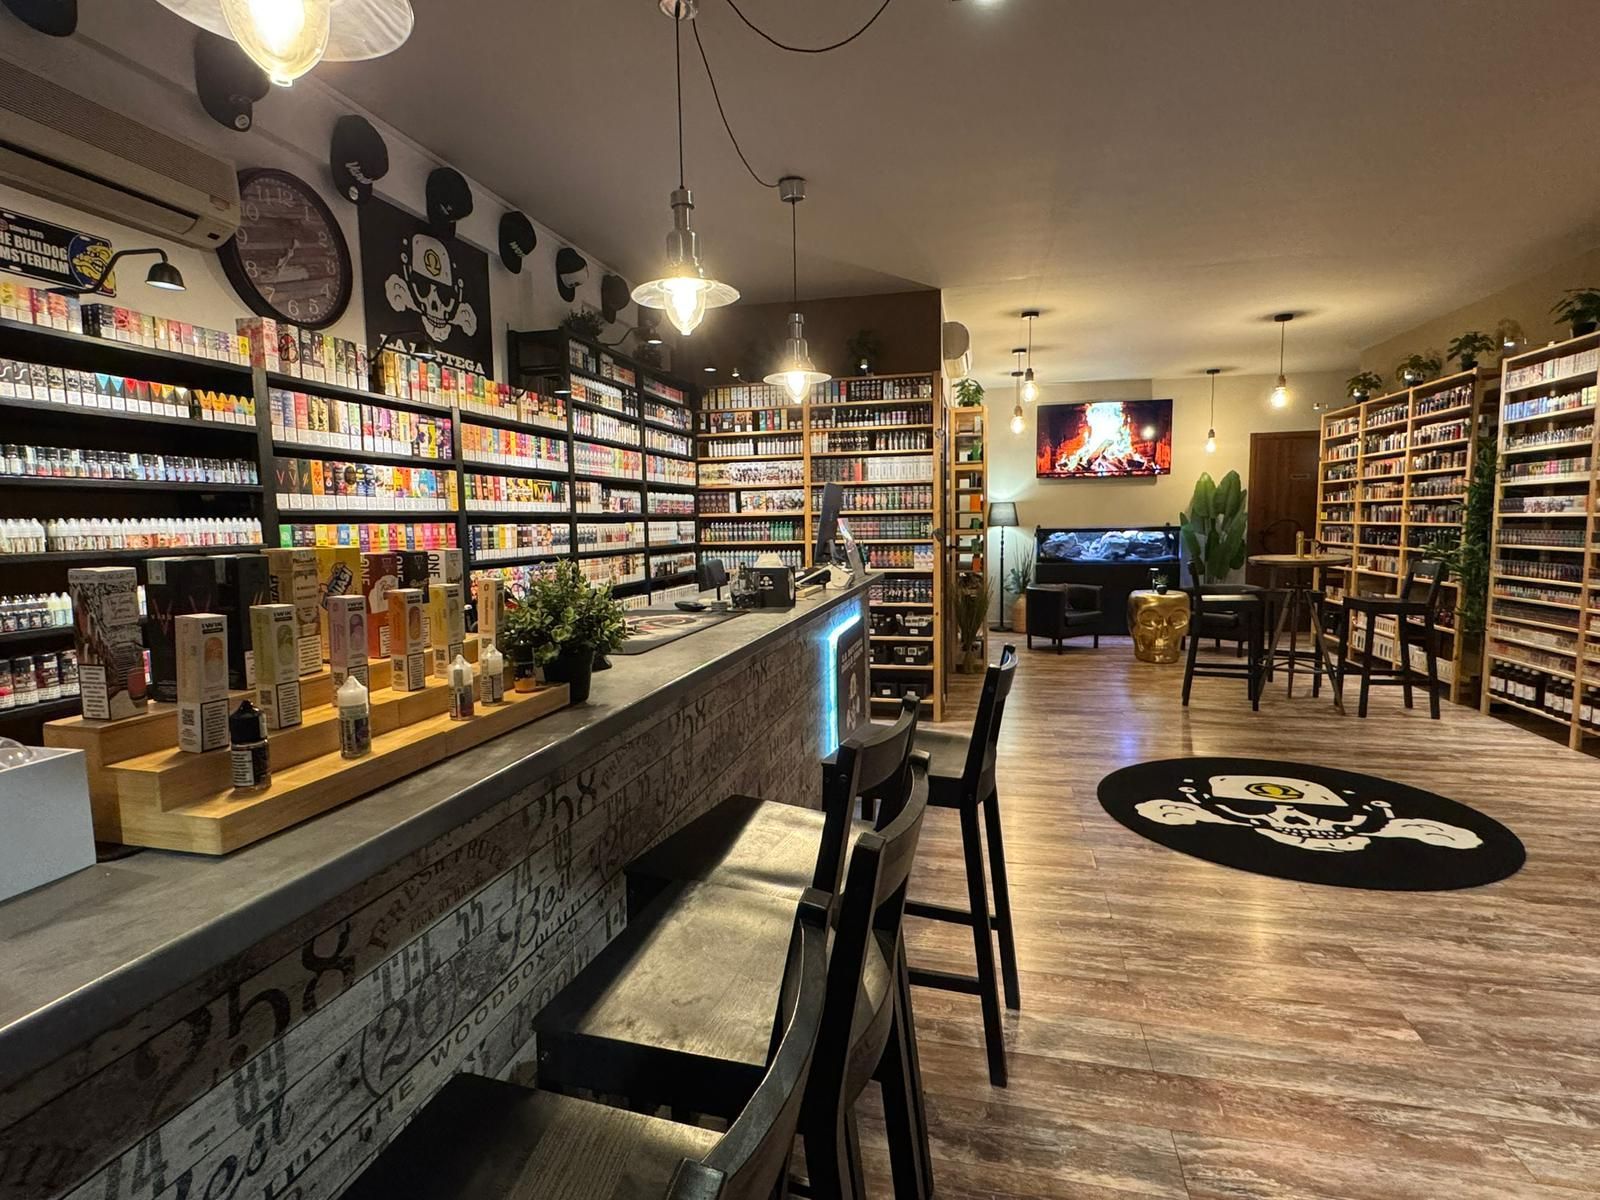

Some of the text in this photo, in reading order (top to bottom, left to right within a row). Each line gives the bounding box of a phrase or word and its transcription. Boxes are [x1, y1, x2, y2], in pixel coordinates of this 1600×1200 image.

[0, 246, 70, 275] MSTERDAM
[13, 235, 69, 263] BULLDOG
[287, 299, 299, 317] 6
[428, 553, 440, 579] ONE
[352, 1076, 415, 1146] THE
[430, 948, 546, 1068] WOODBOX
